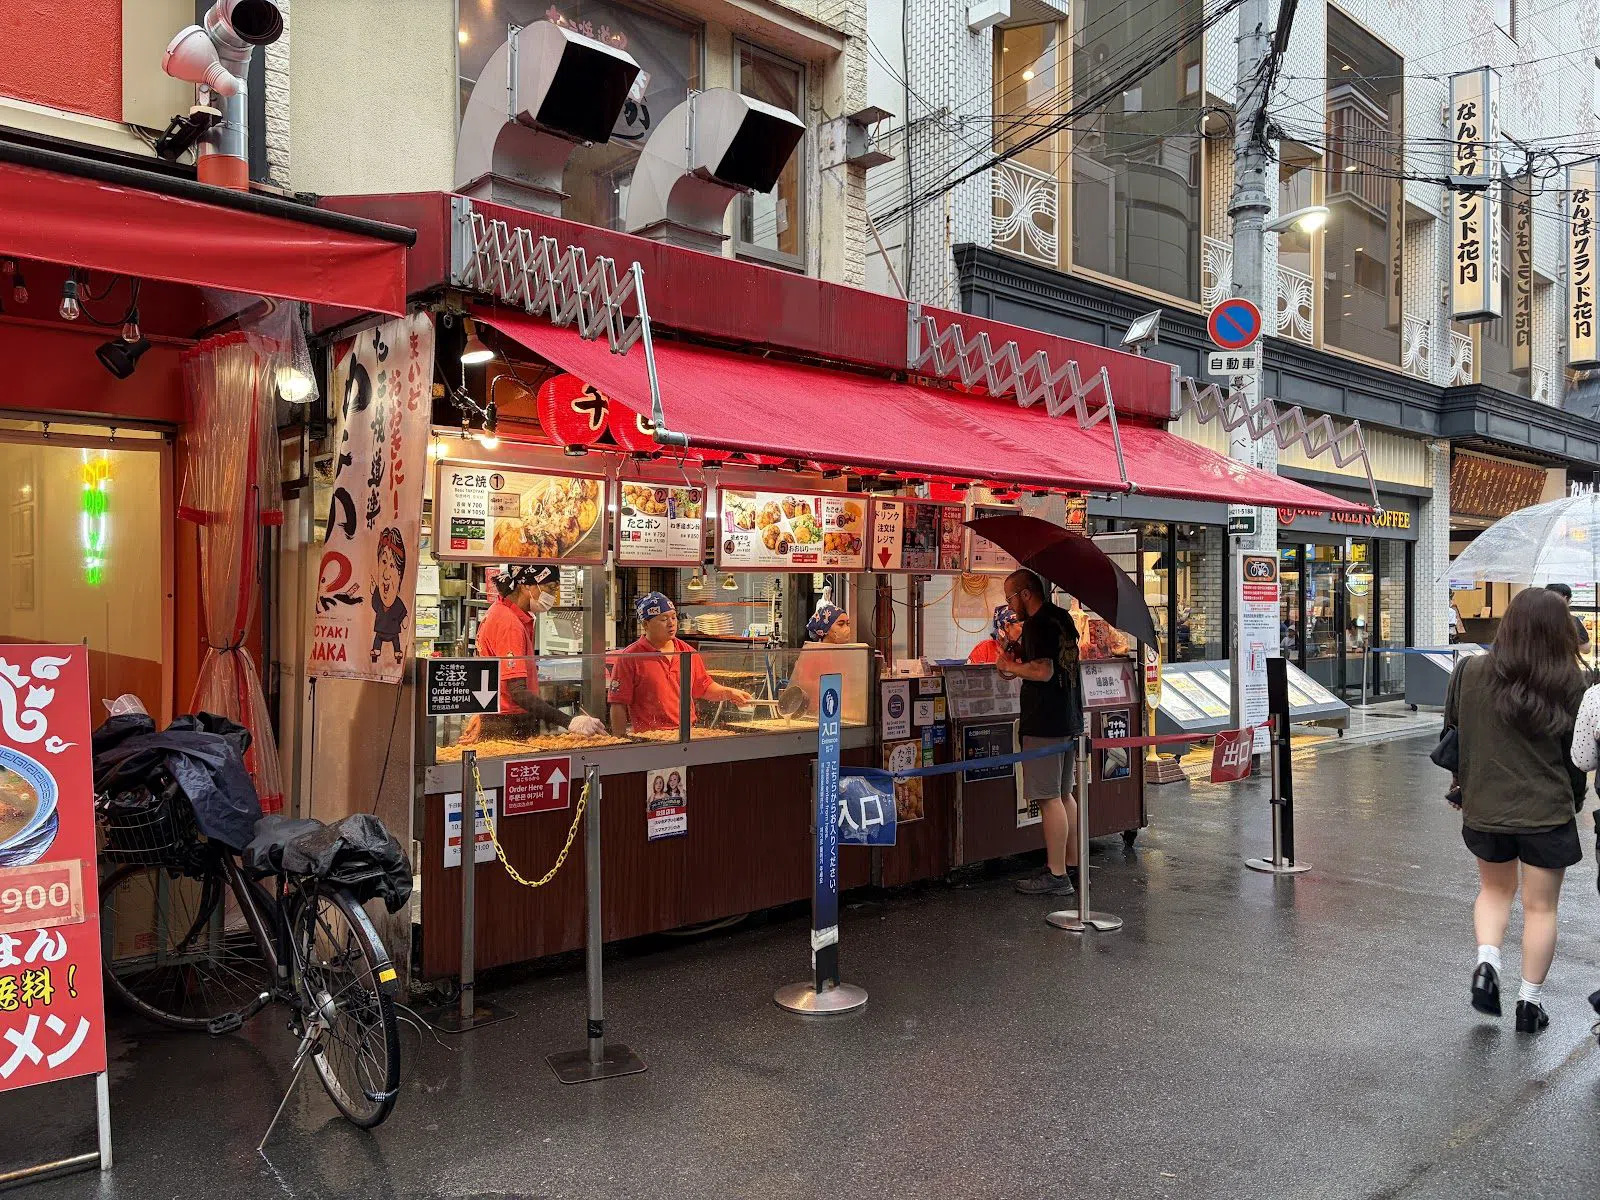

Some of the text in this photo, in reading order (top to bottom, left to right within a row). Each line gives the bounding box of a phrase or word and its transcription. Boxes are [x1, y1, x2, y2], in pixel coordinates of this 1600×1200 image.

[1572, 188, 1593, 339] なんばグランド花月
[1211, 357, 1255, 370] 自動車
[407, 331, 421, 412] まいど
[452, 473, 487, 488] たこ焼
[875, 511, 900, 523] ドリンク
[1372, 510, 1411, 529] COFFEE
[627, 518, 661, 530] たこポン
[877, 523, 895, 533] 注文は
[876, 536, 895, 544] レジで
[435, 670, 468, 682] ご注文
[431, 687, 452, 695] Order
[431, 695, 471, 704] 주문은 여기서
[821, 721, 838, 737] 入口
[1221, 741, 1250, 768] 出口
[509, 765, 541, 778] ご注文
[508, 784, 544, 793] Order Here
[527, 792, 544, 800] 여기서
[838, 794, 884, 831] 入口
[0, 1013, 91, 1080] メン
